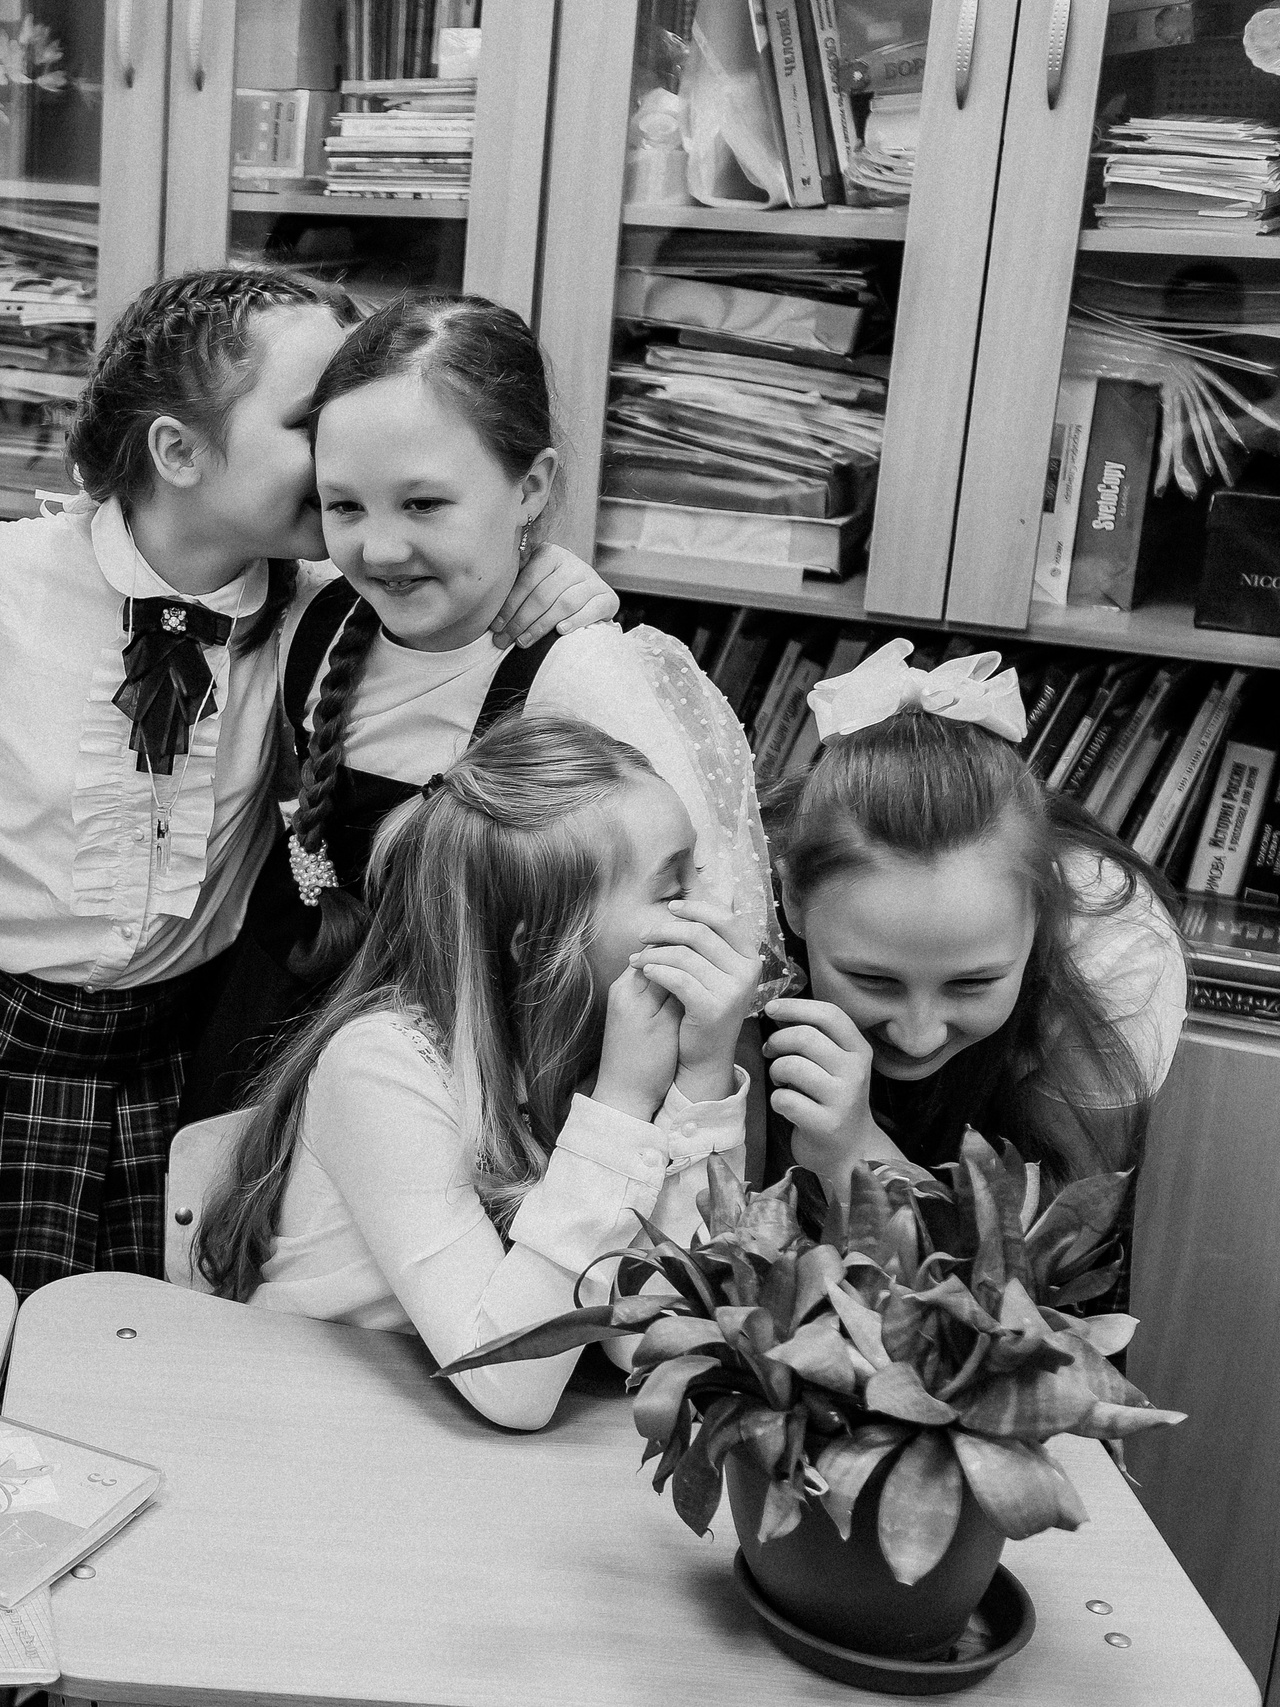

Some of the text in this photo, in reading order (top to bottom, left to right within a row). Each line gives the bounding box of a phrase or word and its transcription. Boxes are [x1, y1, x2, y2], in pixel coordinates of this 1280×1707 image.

[775, 7, 797, 77] ЧЕЛОВЕК
[1090, 460, 1126, 531] SvetoCopy
[1205, 852, 1226, 891] ИМОВА
